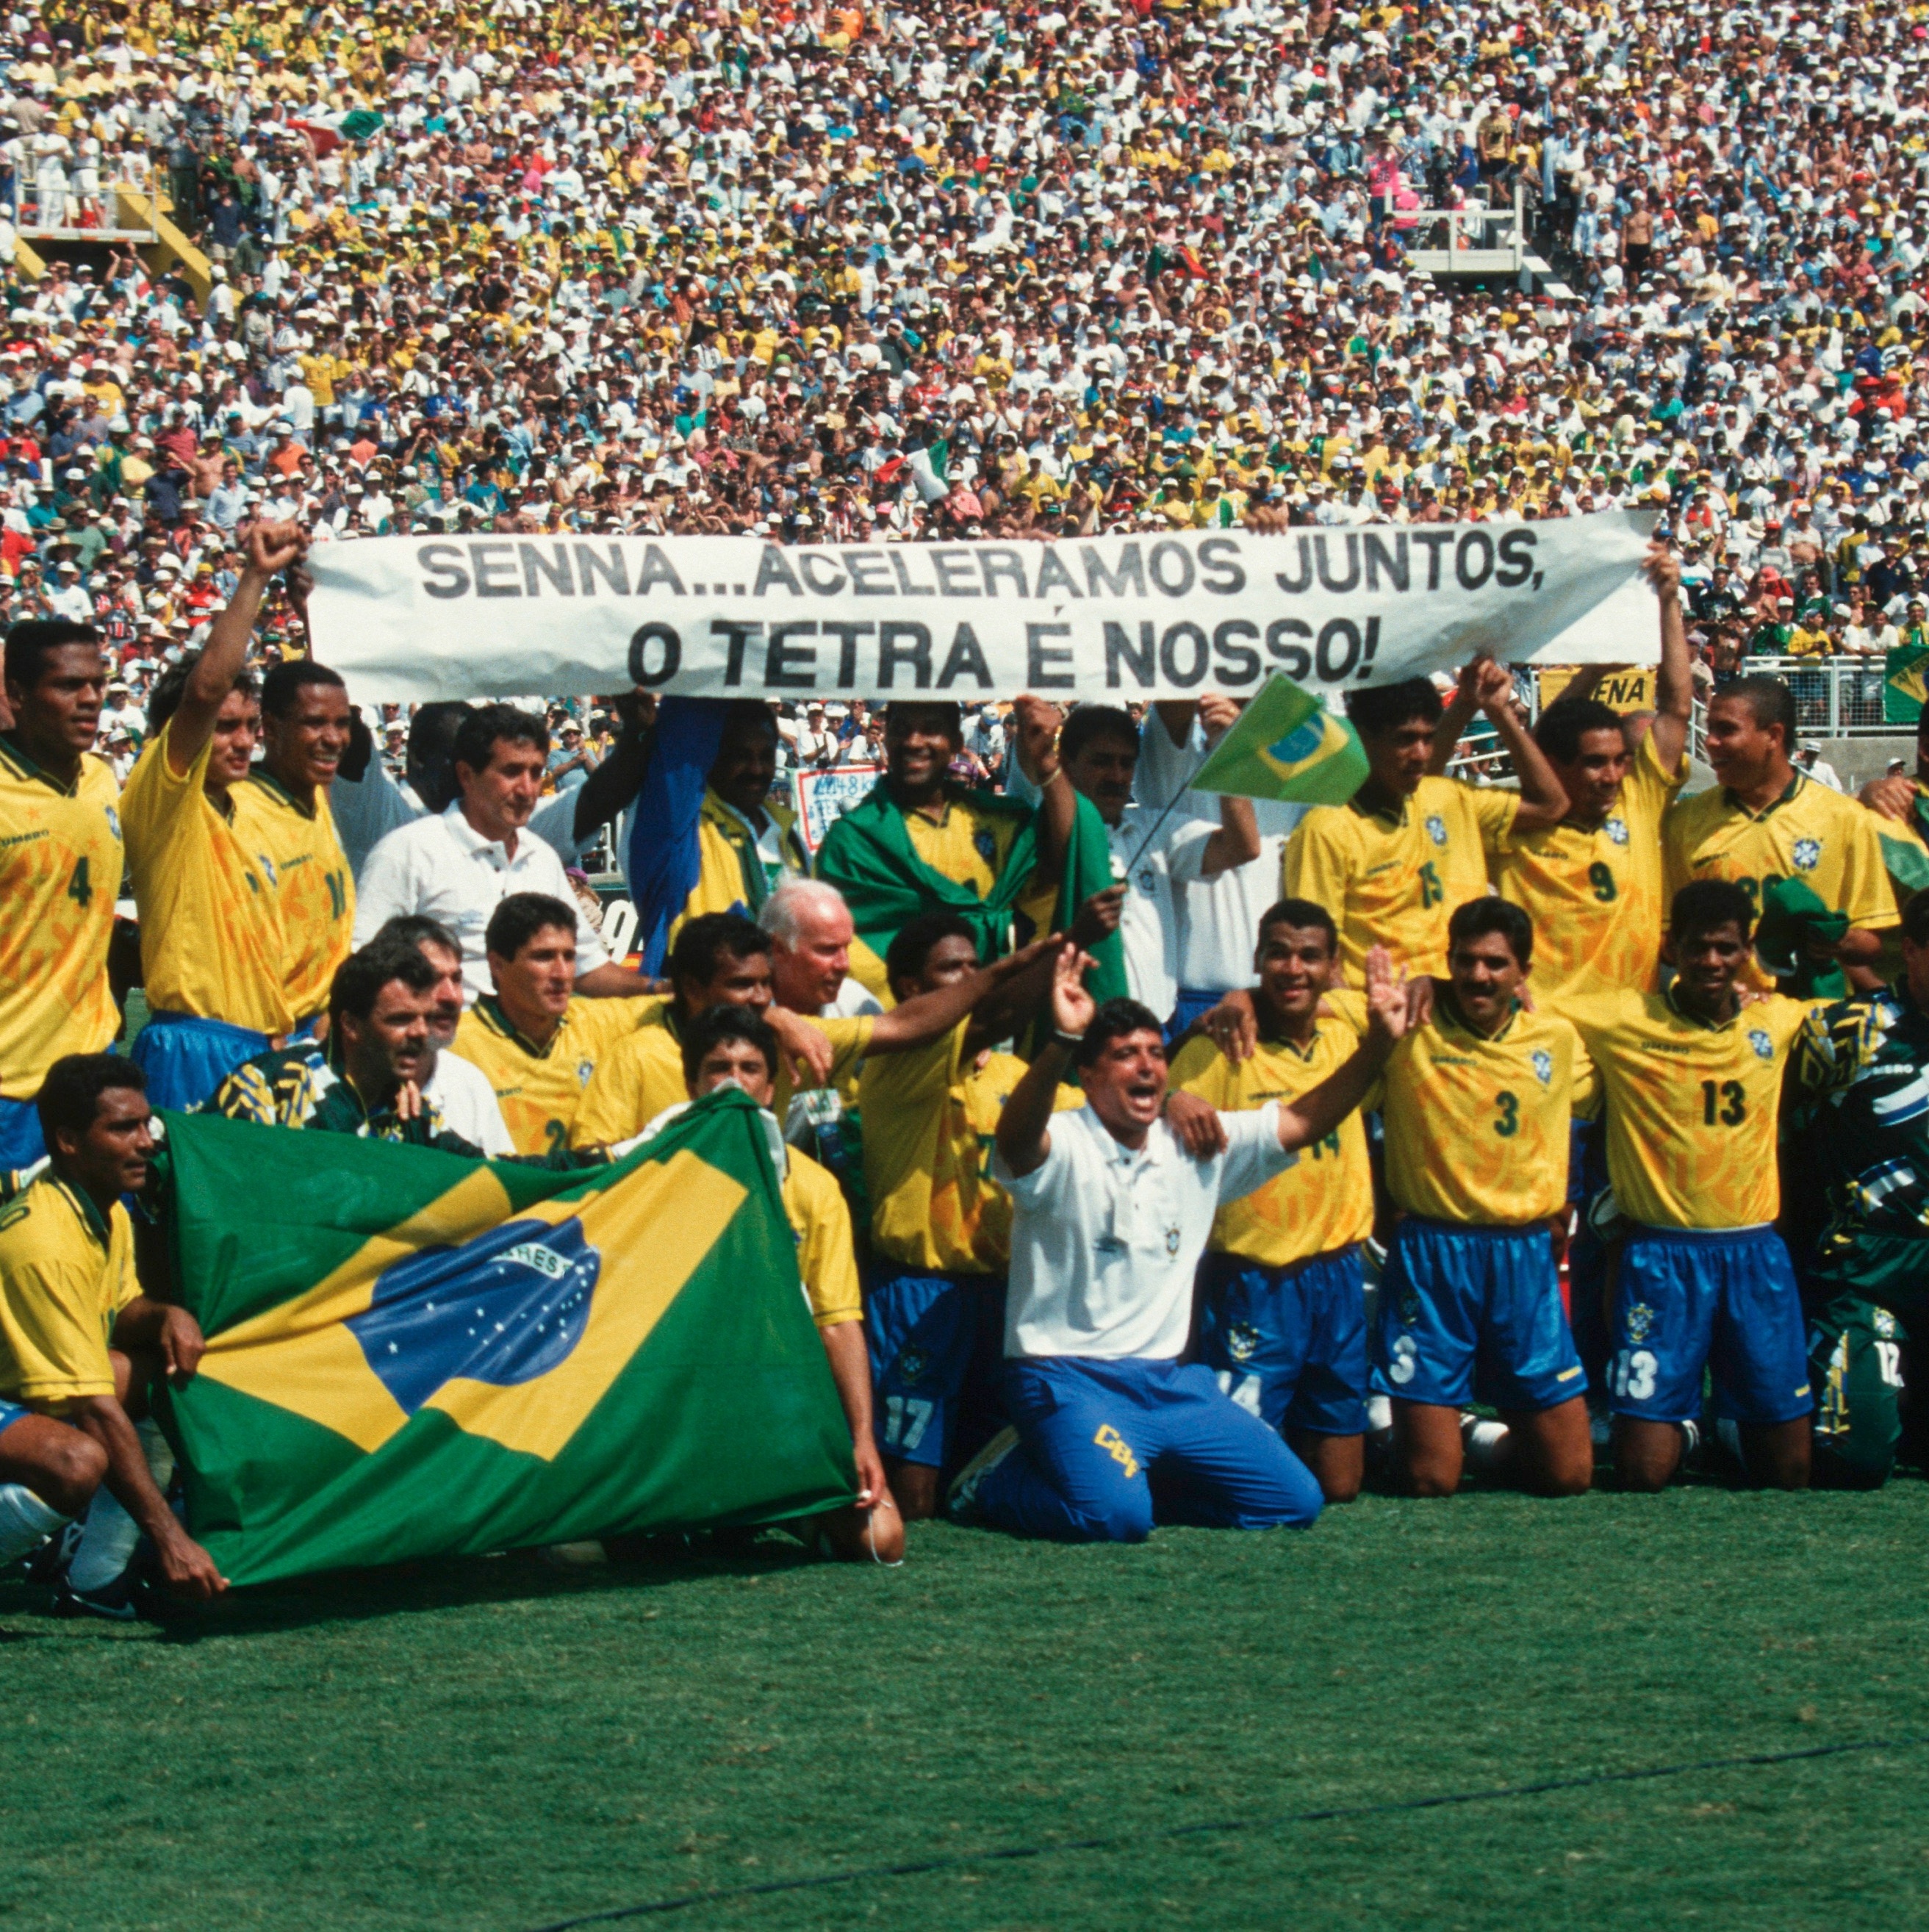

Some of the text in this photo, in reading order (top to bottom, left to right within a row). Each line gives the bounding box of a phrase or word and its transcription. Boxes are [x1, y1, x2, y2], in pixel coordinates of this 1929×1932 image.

[1275, 528, 1544, 594] JUNTOS,
[628, 606, 1381, 689] O TETRA É NOSSO!
[68, 855, 93, 908] 4
[1588, 860, 1617, 903] 9
[1494, 1090, 1519, 1138] 3
[1701, 1079, 1746, 1127] 13
[1389, 1335, 1418, 1385] 3
[1615, 1349, 1659, 1400] 13
[884, 1395, 933, 1450] 17
